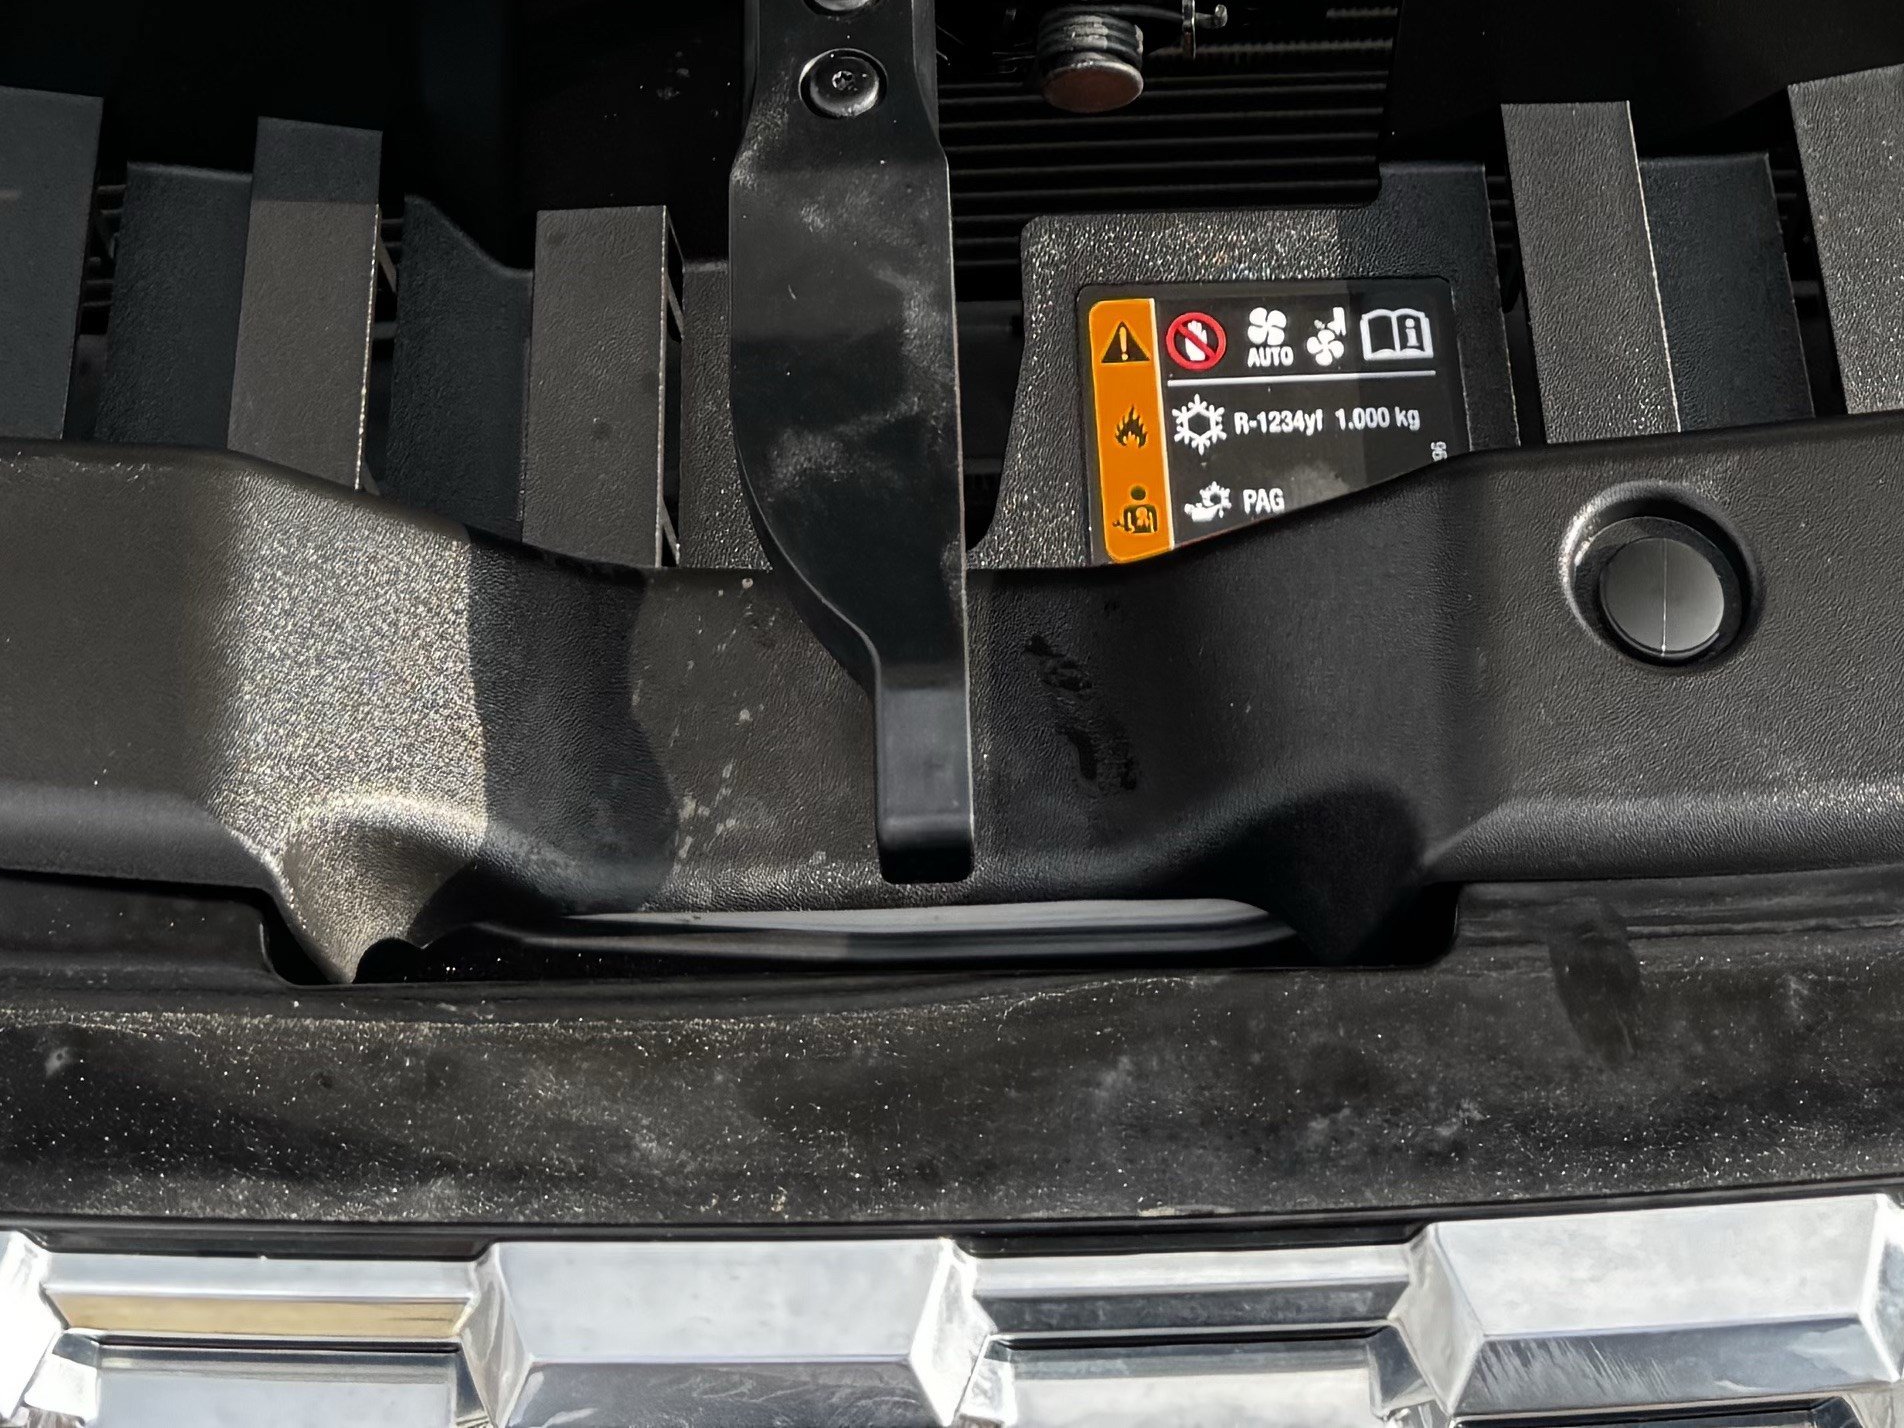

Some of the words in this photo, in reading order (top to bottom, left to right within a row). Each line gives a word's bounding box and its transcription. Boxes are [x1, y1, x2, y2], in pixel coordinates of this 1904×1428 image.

[1247, 346, 1294, 368] AUTO
[1233, 408, 1324, 436] R-1234yf
[1334, 407, 1391, 431] 1.000
[1394, 406, 1421, 432] kg
[1242, 487, 1286, 515] PAG
